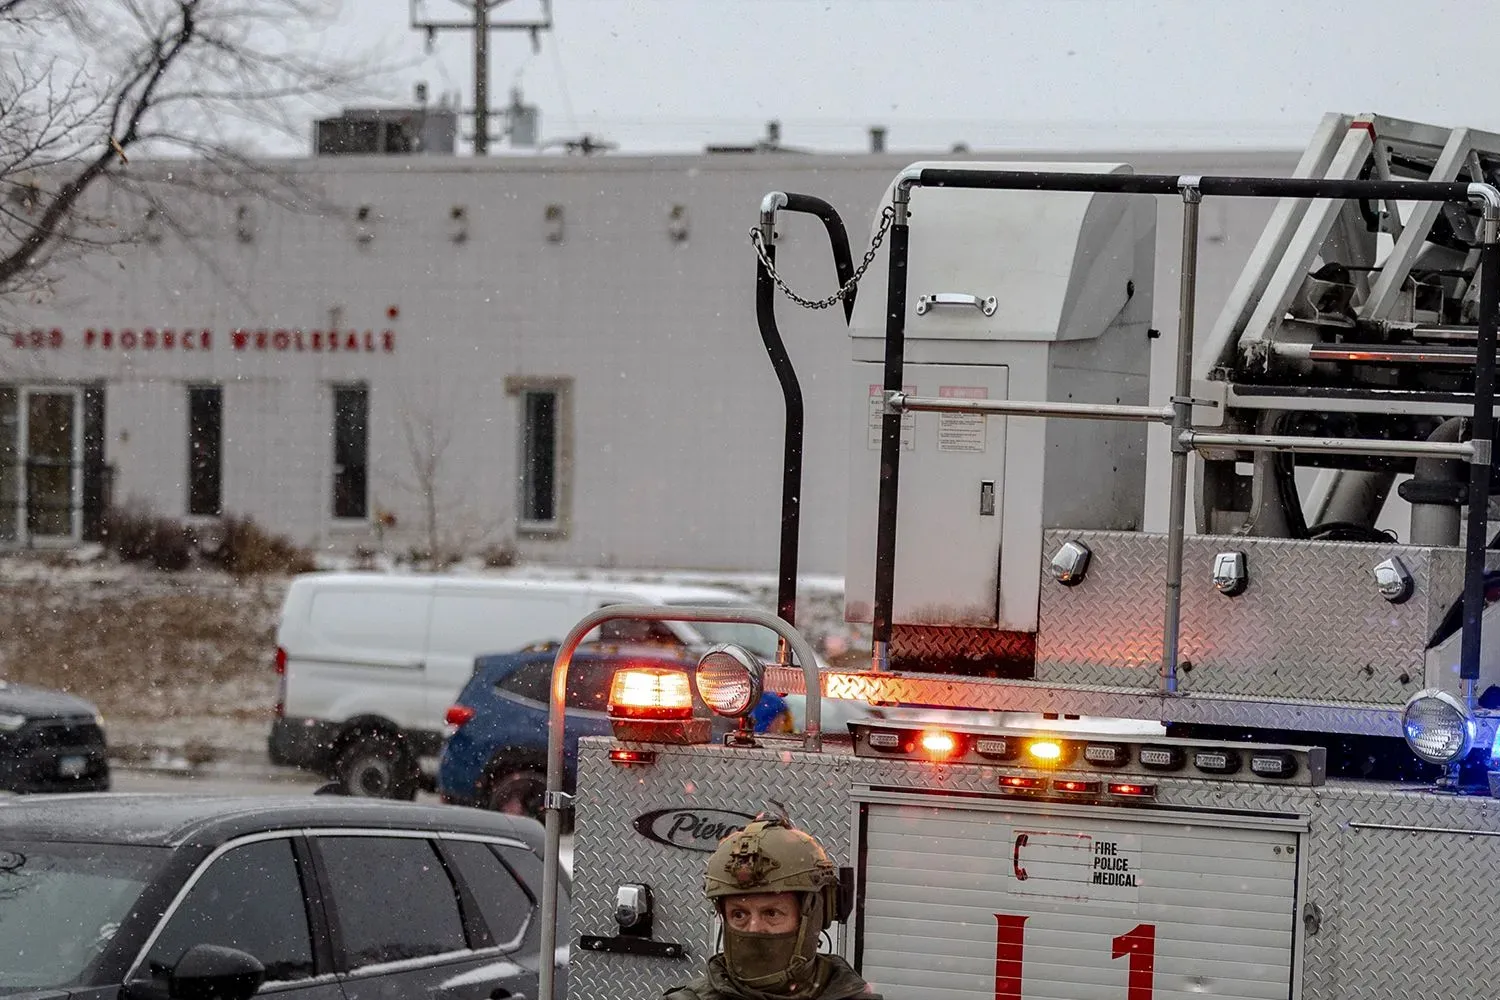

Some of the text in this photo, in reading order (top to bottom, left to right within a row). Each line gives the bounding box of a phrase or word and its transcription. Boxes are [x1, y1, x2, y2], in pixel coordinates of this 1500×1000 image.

[667, 812, 747, 843] Pierc
[1095, 841, 1118, 856] FIRE
[1094, 857, 1129, 872] POLICE
[1093, 872, 1138, 888] MEDICAL
